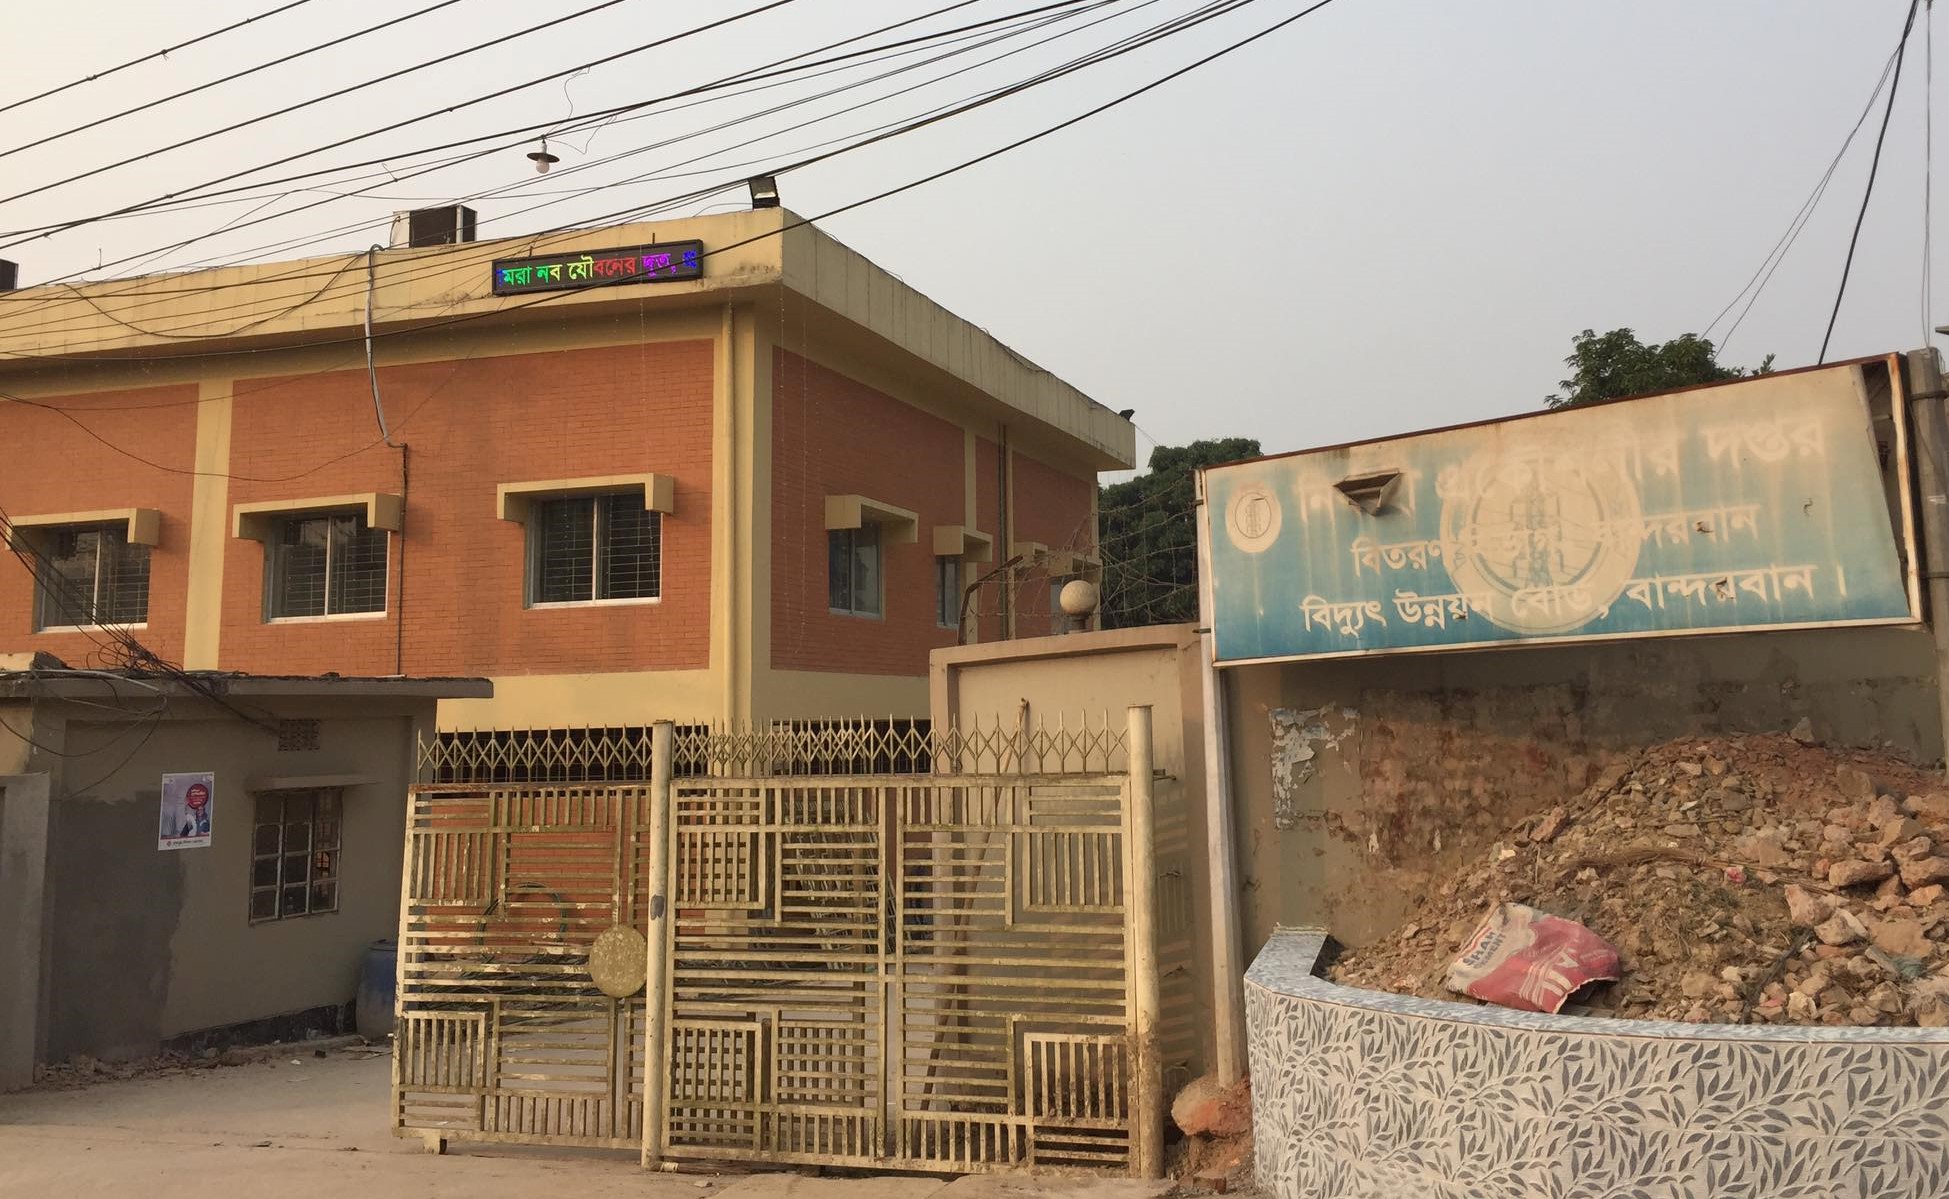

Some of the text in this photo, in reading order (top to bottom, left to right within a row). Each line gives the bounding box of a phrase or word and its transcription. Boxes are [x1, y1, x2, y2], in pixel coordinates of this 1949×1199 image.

[497, 264, 532, 287] মরা
[536, 263, 563, 284] নব
[568, 255, 637, 280] যৌবনের
[1699, 416, 1827, 469] দপ্তর
[1300, 594, 1387, 637] বিদ্যুৎ
[1392, 588, 1494, 631] উন্নয়ন
